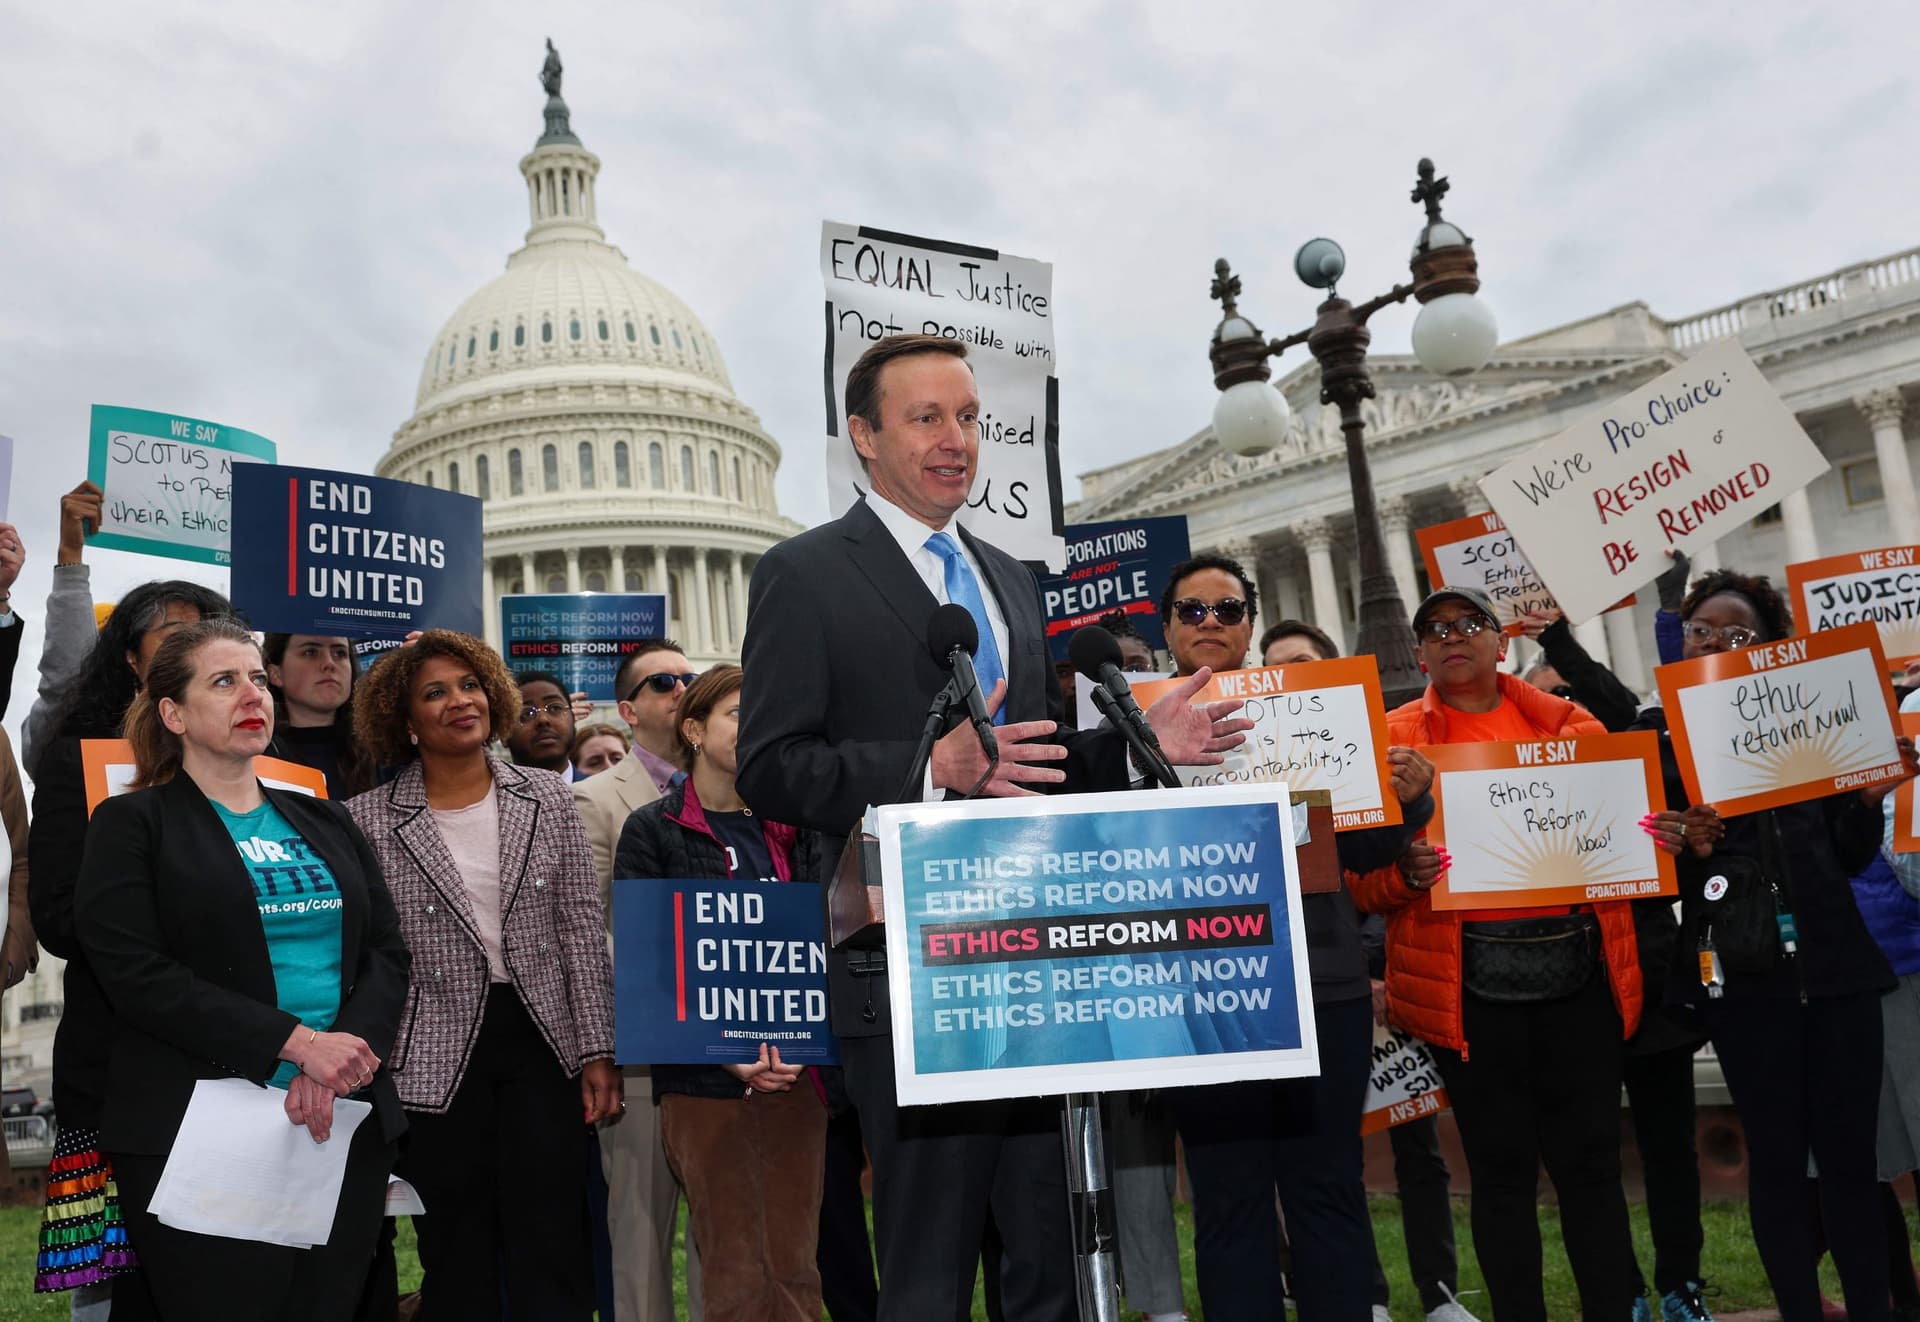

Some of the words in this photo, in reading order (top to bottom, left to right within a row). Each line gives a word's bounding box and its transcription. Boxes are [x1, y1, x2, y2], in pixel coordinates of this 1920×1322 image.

[832, 239, 944, 298] EQUAL
[957, 262, 1048, 317] Justice
[838, 309, 903, 340] not
[922, 321, 1004, 350] possible
[1015, 340, 1051, 361] with
[171, 420, 190, 437] WE
[195, 425, 218, 443] SAY
[1713, 429, 1724, 445] or
[112, 435, 208, 470] SCOTUS
[158, 473, 184, 492] to
[1512, 452, 1592, 507] We're
[1592, 448, 1693, 525] RESIGN
[310, 479, 372, 515] END
[1602, 539, 1640, 576] BE
[1656, 462, 1770, 544] REMOVED
[309, 523, 445, 569] CITIZENS
[1065, 529, 1147, 566] PORATIONS
[1860, 552, 1884, 570] WE
[1885, 548, 1914, 566] SAY
[1069, 566, 1093, 581] ARE
[1095, 560, 1119, 575] NOT
[309, 567, 423, 606] UNITED
[1045, 570, 1149, 617] PEOPLE
[331, 606, 411, 619] ENDCITIZENSUNITED.ORG
[511, 613, 558, 624] ETHICS
[561, 612, 617, 623] REFORM
[621, 611, 654, 622] NOW
[511, 626, 558, 637] ETHICS
[561, 625, 617, 636] REFORM
[621, 625, 654, 636] NOW
[512, 643, 559, 655] ETHICS
[561, 643, 618, 654] REFORM
[1747, 647, 1778, 671] WE
[1779, 639, 1808, 665] SAY
[512, 661, 558, 672] ETHICS
[562, 660, 617, 671] REFORM
[1218, 674, 1248, 697] WE
[1249, 669, 1285, 693] SAY
[1291, 726, 1335, 745] the
[1731, 720, 1812, 756] reform
[1516, 742, 1542, 765] WE
[1545, 740, 1577, 764] SAY
[1834, 763, 1905, 790] CPDACTION.ORG
[1524, 808, 1587, 832] Reform
[1576, 827, 1613, 856] Now!
[923, 854, 1033, 882] ETHICS
[1042, 846, 1170, 876] REFORM
[1179, 841, 1256, 868] NOW
[926, 885, 1036, 914] ETHICS
[1045, 878, 1173, 907] REFORM
[1182, 873, 1260, 899] NOW
[1586, 880, 1661, 899] CPDACTION.ORG
[696, 891, 764, 924] END
[928, 927, 1040, 957] ETHICS
[1048, 920, 1177, 949] REFORM
[1186, 914, 1265, 941] NOW
[931, 970, 1043, 1000] ETHICS
[1052, 961, 1182, 992] REFORM
[1191, 956, 1268, 983] NOW
[699, 987, 826, 1022] UNITED
[934, 1003, 1045, 1033] ETHICS
[1055, 993, 1184, 1024] REFORM
[1194, 988, 1272, 1015] NOW
[724, 1030, 812, 1040] ENDCITIZENSUNITED.ORG
[1389, 1101, 1417, 1123] SAY
[1418, 1094, 1440, 1115] WE
